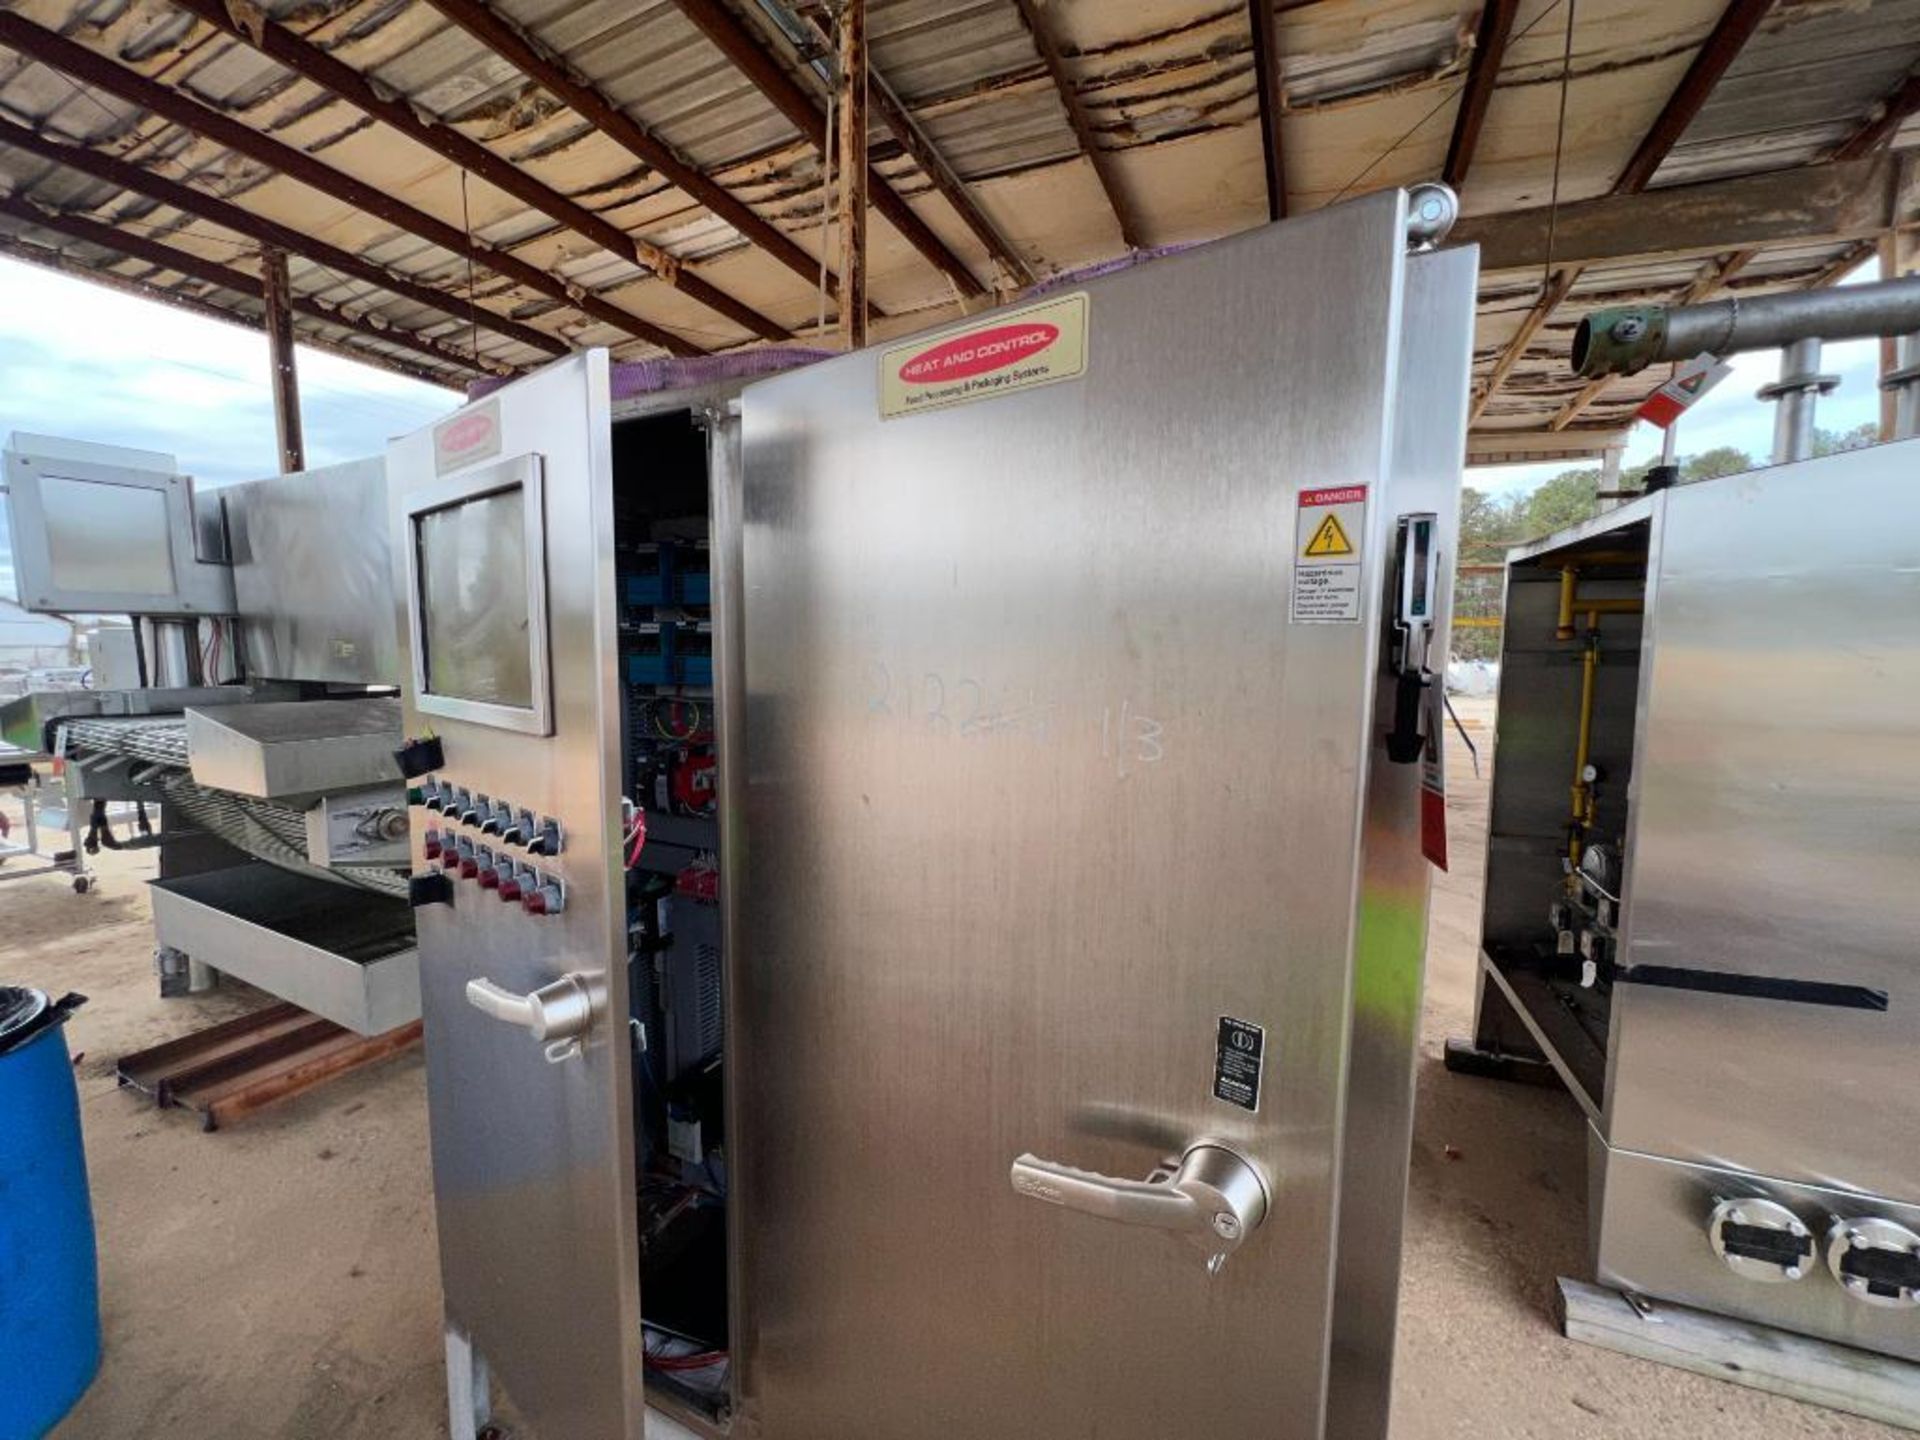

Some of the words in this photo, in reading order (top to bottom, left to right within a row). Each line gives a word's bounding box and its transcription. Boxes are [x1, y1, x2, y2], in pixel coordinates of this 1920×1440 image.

[905, 358, 940, 377] HEAT
[944, 350, 975, 368] AND
[976, 330, 1051, 359] CONTROL
[963, 381, 971, 392] &
[971, 373, 1011, 391] Packaging
[1012, 364, 1050, 382] Systems
[1315, 489, 1362, 503] DANGER
